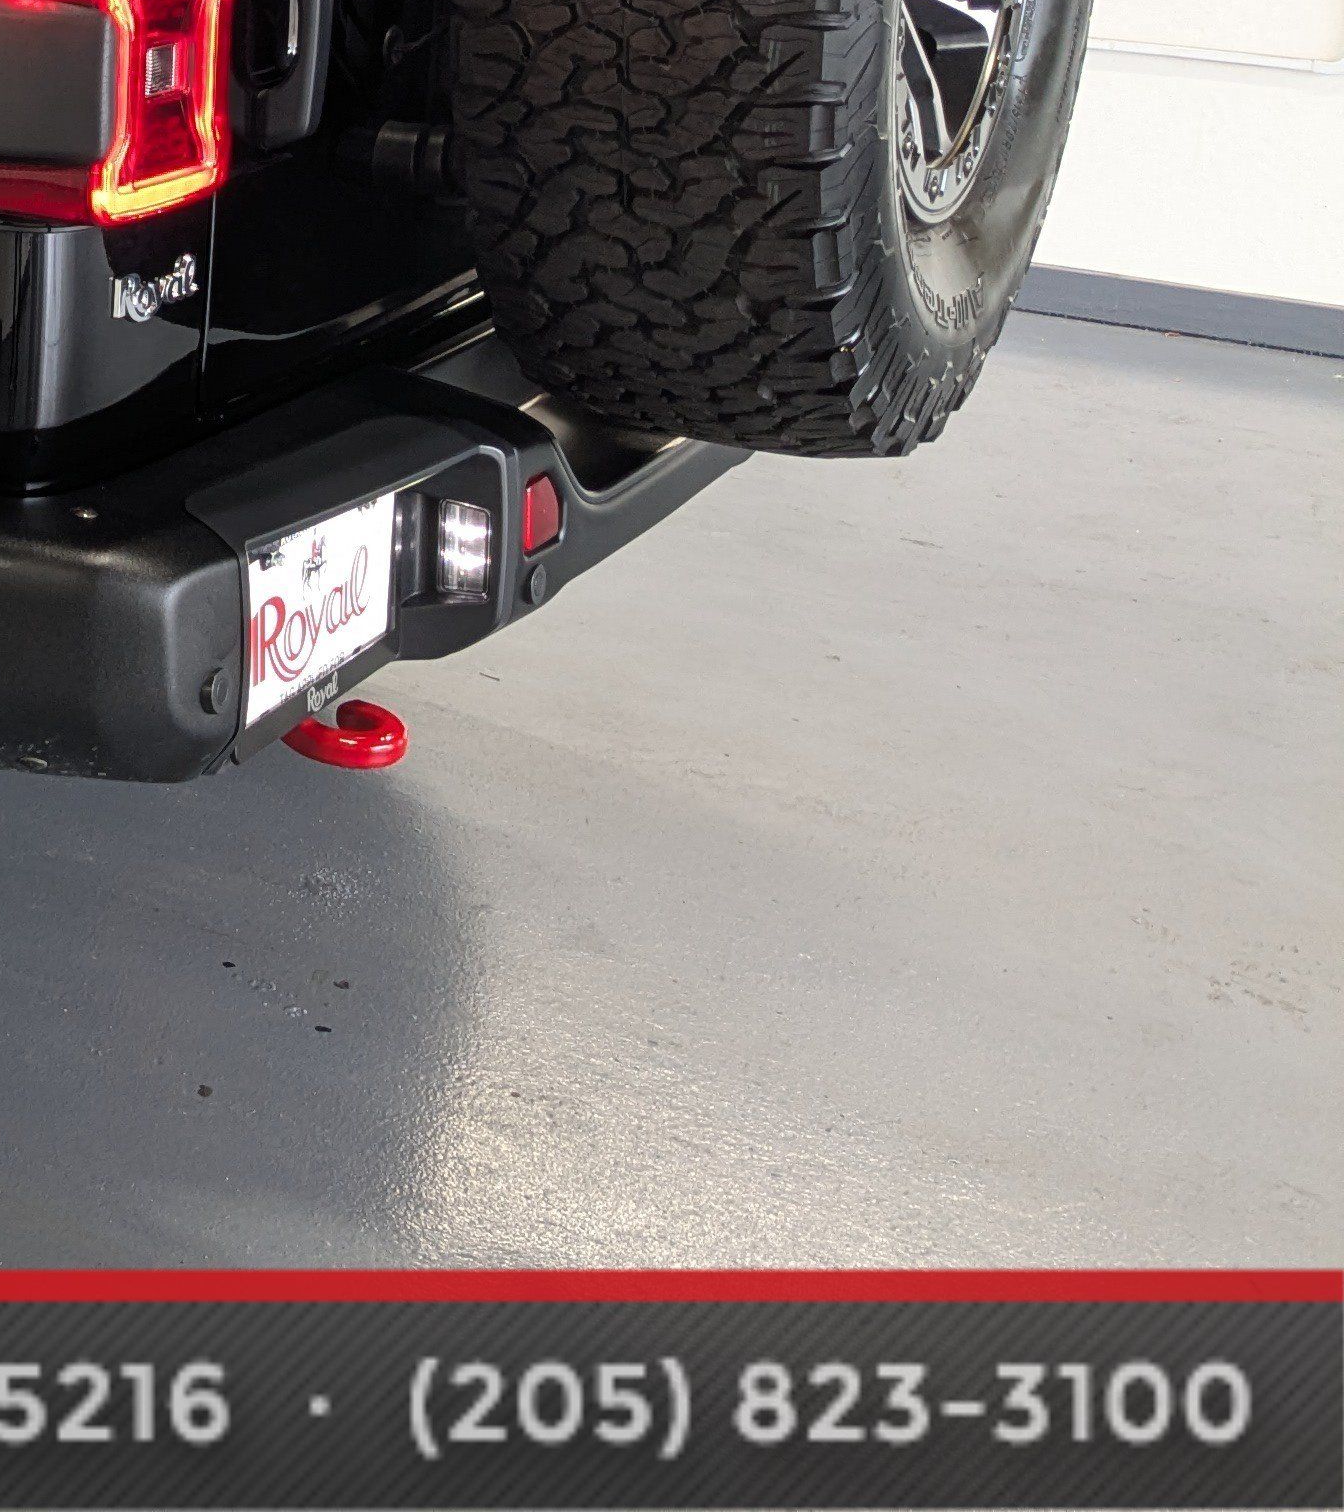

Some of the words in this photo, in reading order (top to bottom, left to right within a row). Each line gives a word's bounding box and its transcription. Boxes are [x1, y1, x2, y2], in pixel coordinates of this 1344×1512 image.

[111, 253, 199, 323] Royal
[249, 544, 370, 688] Royal
[307, 671, 339, 713] Royal
